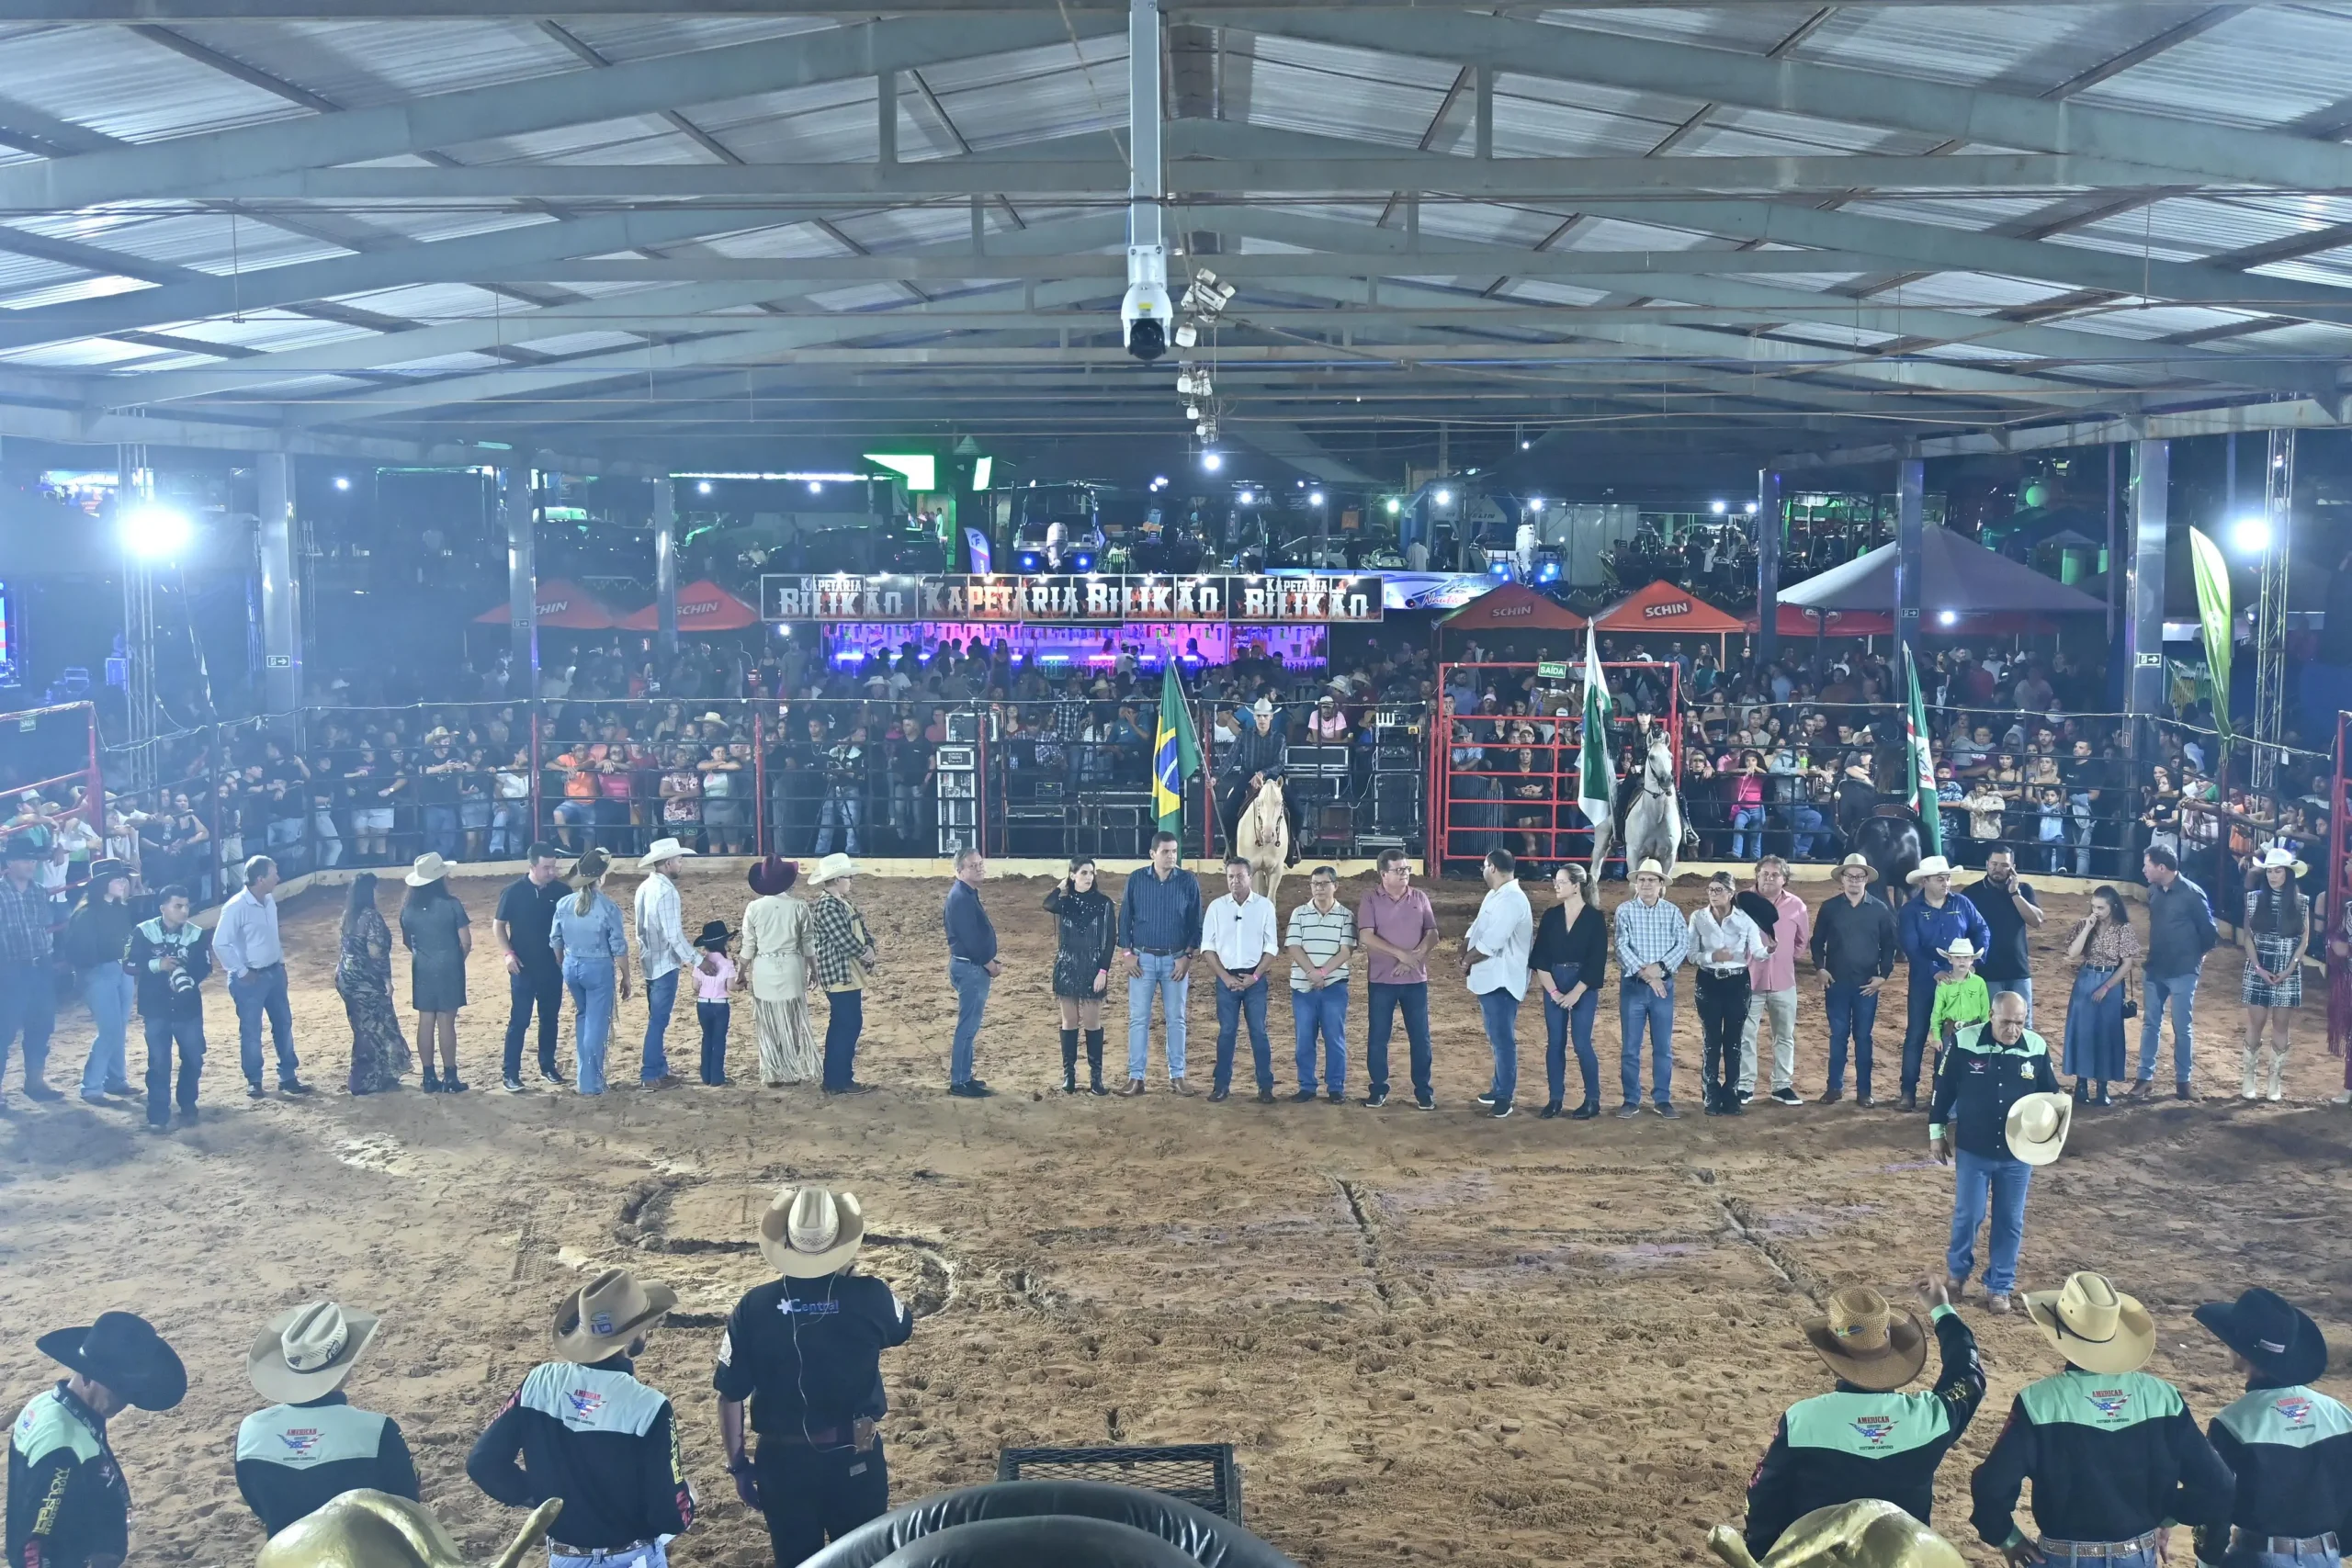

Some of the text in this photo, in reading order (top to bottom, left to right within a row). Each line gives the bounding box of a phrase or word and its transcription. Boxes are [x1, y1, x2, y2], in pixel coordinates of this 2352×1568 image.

[800, 578, 862, 592] KAPETARIA
[1266, 579, 1329, 592] KAPETARIA
[779, 586, 903, 615] BILIKÃO
[924, 581, 1220, 613] KAPETARIA BILIKÃO
[1244, 589, 1369, 616] BILIKÃO
[534, 601, 568, 615] CHIN
[1492, 605, 1532, 616] SCHIN
[1645, 603, 1688, 617] SCHIN
[1540, 666, 1564, 675] SAÍDA
[790, 1298, 839, 1312] Central
[1858, 1416, 1890, 1424] AMERICAN
